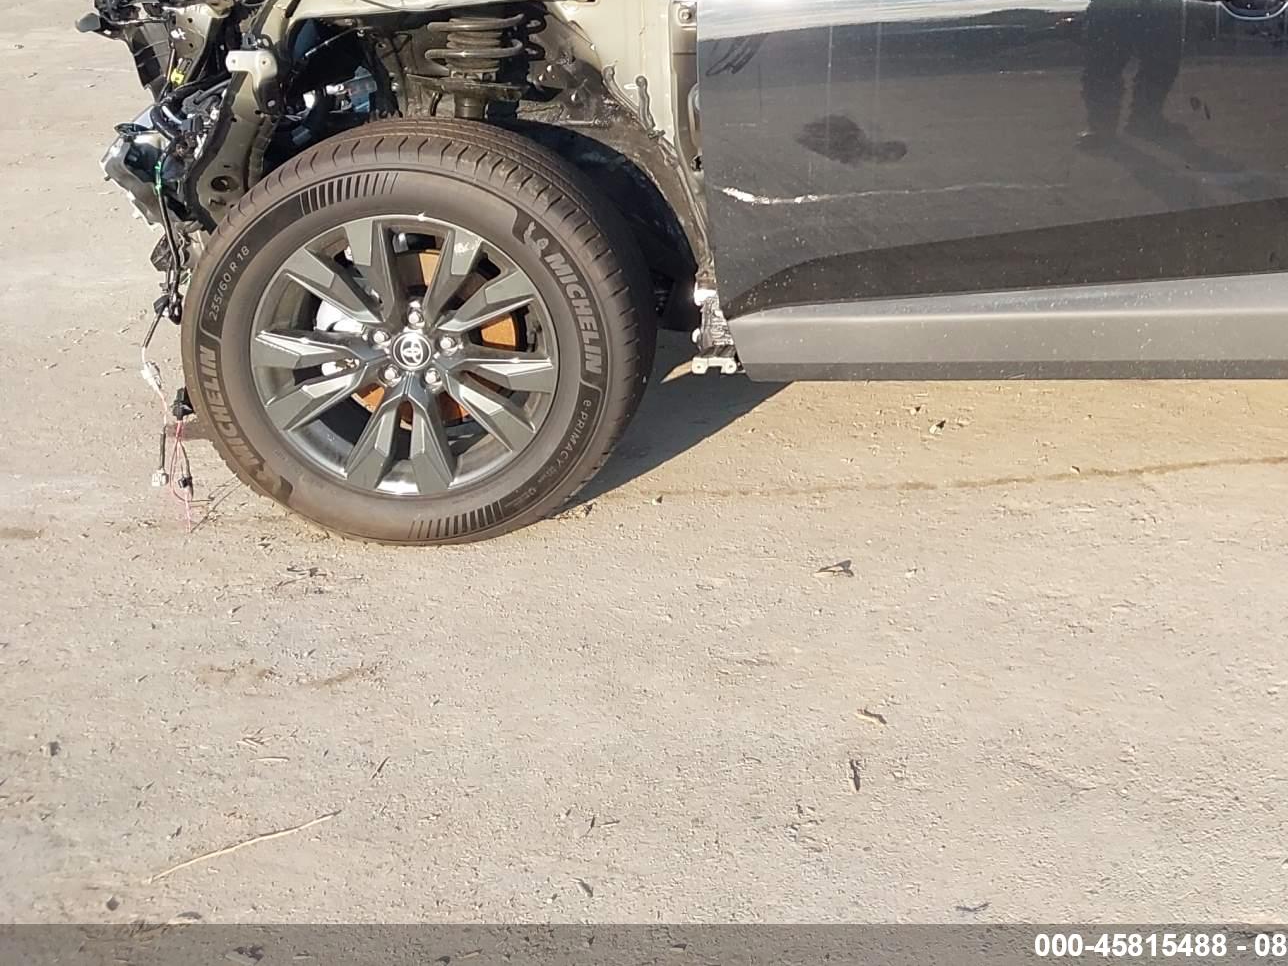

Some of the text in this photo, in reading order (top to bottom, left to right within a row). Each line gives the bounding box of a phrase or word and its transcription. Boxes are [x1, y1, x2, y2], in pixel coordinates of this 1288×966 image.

[208, 245, 250, 321] 235/60 R 18
[544, 251, 603, 374] MICHELIN
[199, 345, 261, 466] MICHELIN
